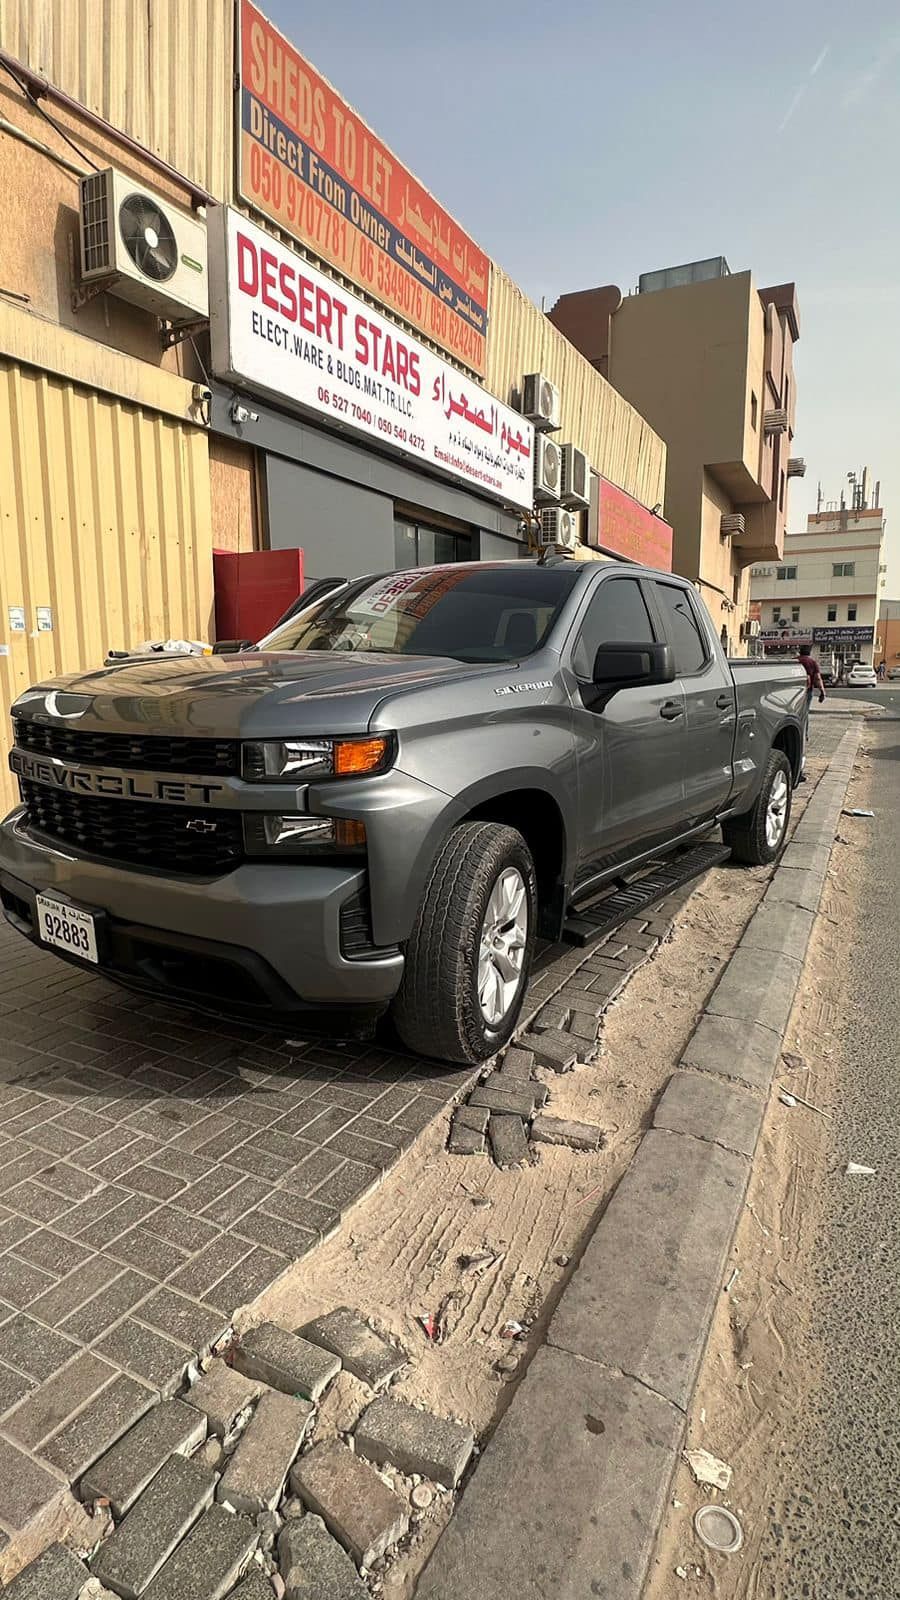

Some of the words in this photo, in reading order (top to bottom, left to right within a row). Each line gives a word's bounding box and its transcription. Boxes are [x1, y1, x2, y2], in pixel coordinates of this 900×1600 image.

[251, 22, 326, 152] SHEDS
[332, 104, 356, 181] TO
[362, 137, 393, 214] LET
[250, 97, 304, 177] Direct
[309, 151, 346, 214] From
[351, 191, 390, 251] Owner
[250, 143, 282, 210] 050
[286, 173, 347, 262] 9707781
[360, 238, 374, 282] 06
[377, 254, 423, 321] 5349076
[430, 296, 447, 339] 050
[449, 309, 482, 367] 6242470
[395, 238, 438, 288] المالك
[237, 231, 348, 351] DESERT
[355, 314, 420, 397] STARS
[439, 279, 453, 301] من
[252, 310, 324, 370] ELECT.WARE
[326, 354, 333, 375] &
[317, 386, 330, 404] 06
[332, 394, 349, 414] 527
[351, 403, 372, 425] 7040
[377, 417, 392, 435] 050
[393, 425, 407, 442] 540
[408, 433, 426, 451] 4272
[432, 370, 498, 436] الصحراء
[501, 421, 531, 462] نجوم
[494, 680, 553, 696] SILVERADO
[11, 756, 224, 804] CHEVROLET
[45, 913, 89, 951] 92883
